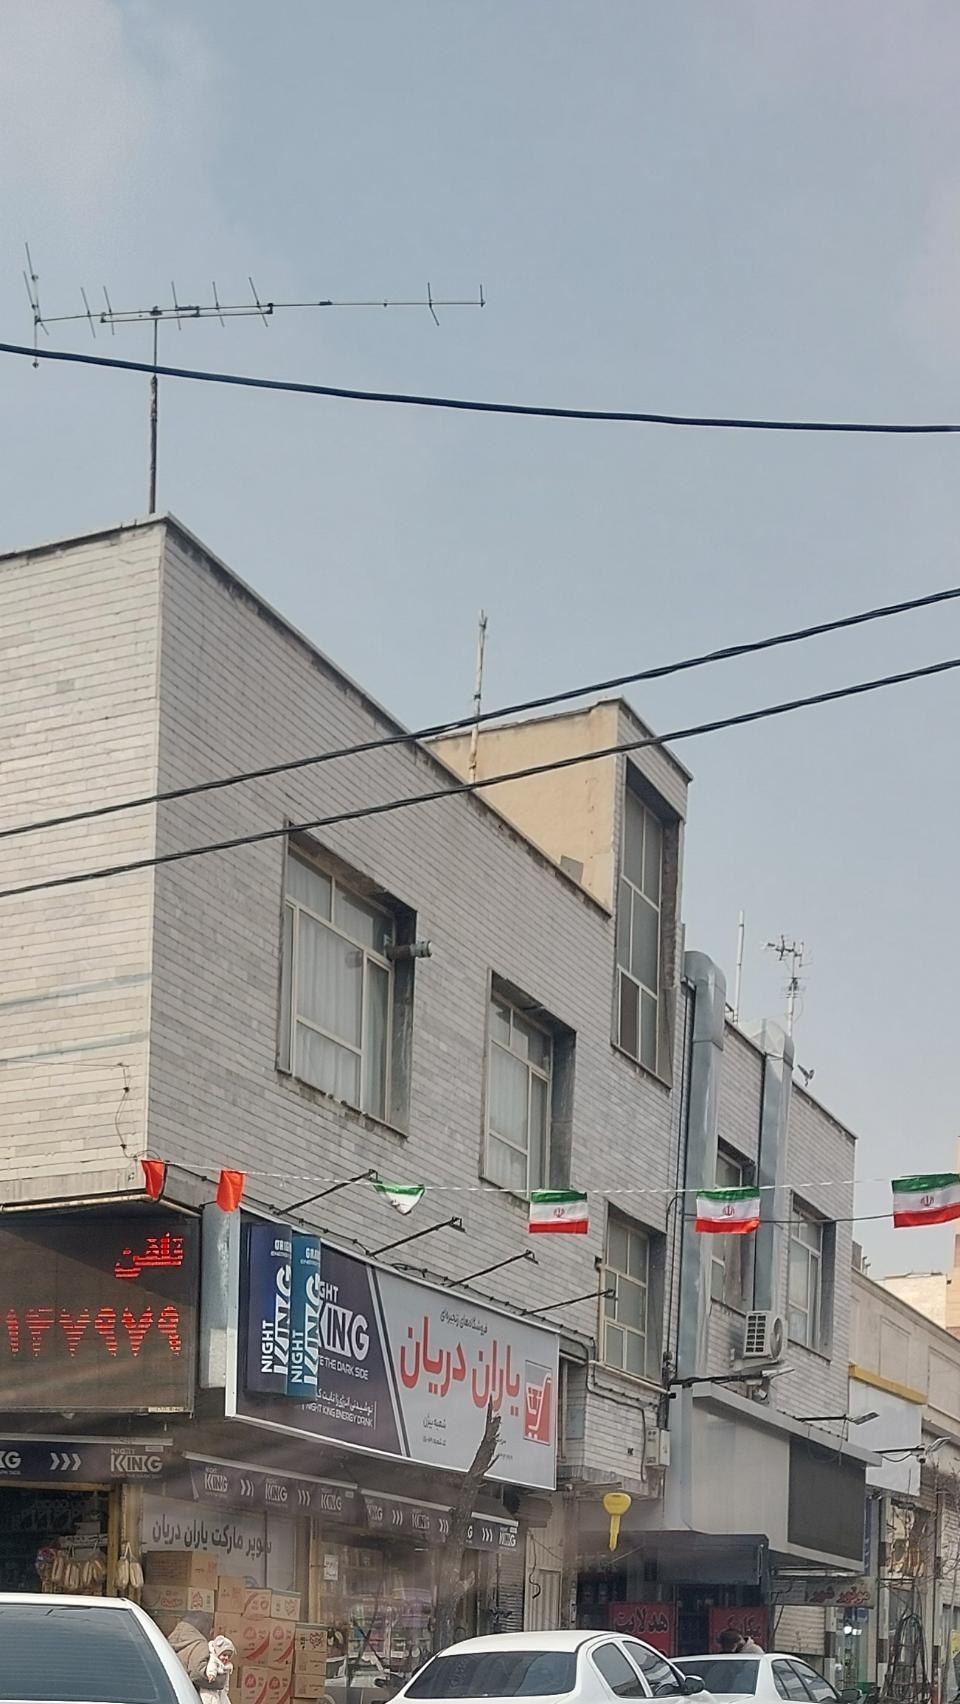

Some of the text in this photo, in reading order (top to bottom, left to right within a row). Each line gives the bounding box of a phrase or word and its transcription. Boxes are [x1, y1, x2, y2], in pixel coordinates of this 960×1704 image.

[114, 1232, 183, 1278] تلفن
[319, 1280, 339, 1301] GHT
[261, 1320, 274, 1373] NIGHT
[291, 1330, 304, 1383] NIGHT
[400, 1316, 520, 1417] یاران دریان
[110, 1455, 164, 1472] KING
[153, 1513, 181, 1544] دریان
[183, 1519, 208, 1550] یاران
[211, 1524, 243, 1554] مارکت
